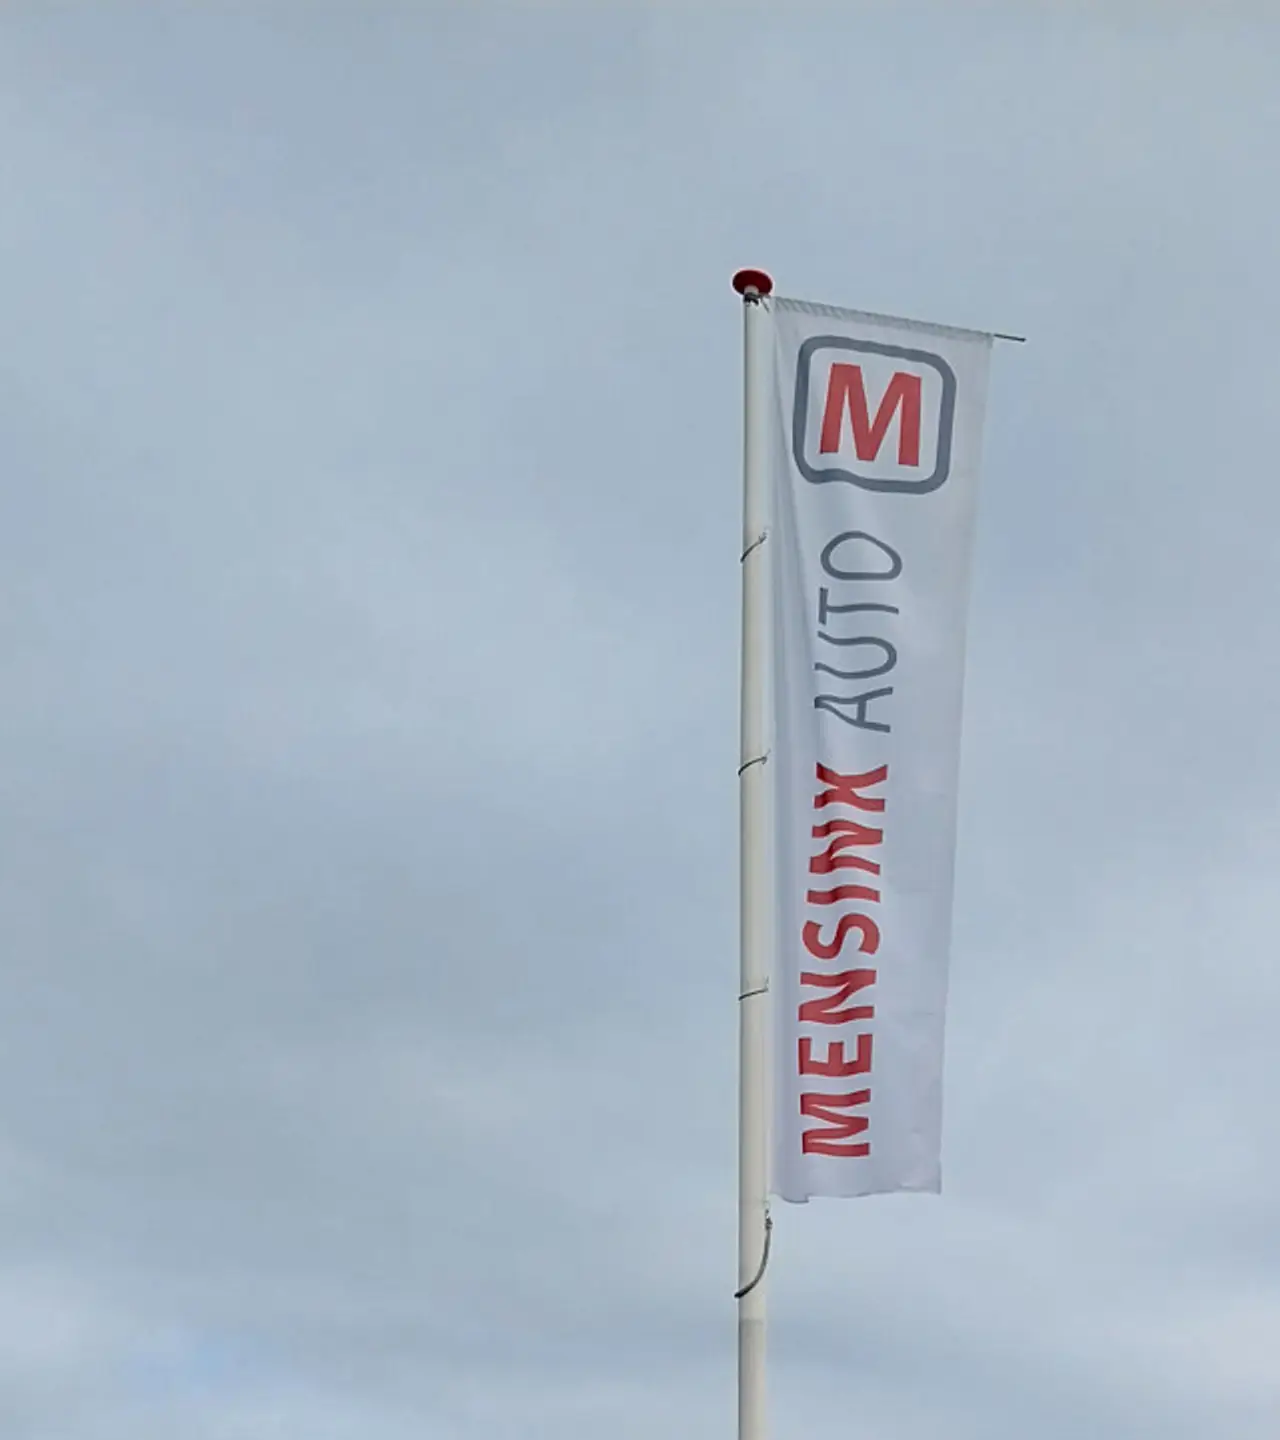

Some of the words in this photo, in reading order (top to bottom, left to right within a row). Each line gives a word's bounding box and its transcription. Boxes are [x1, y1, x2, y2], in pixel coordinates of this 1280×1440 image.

[819, 362, 922, 467] M
[814, 530, 903, 733] AUTO
[798, 761, 889, 1158] MENSINK
